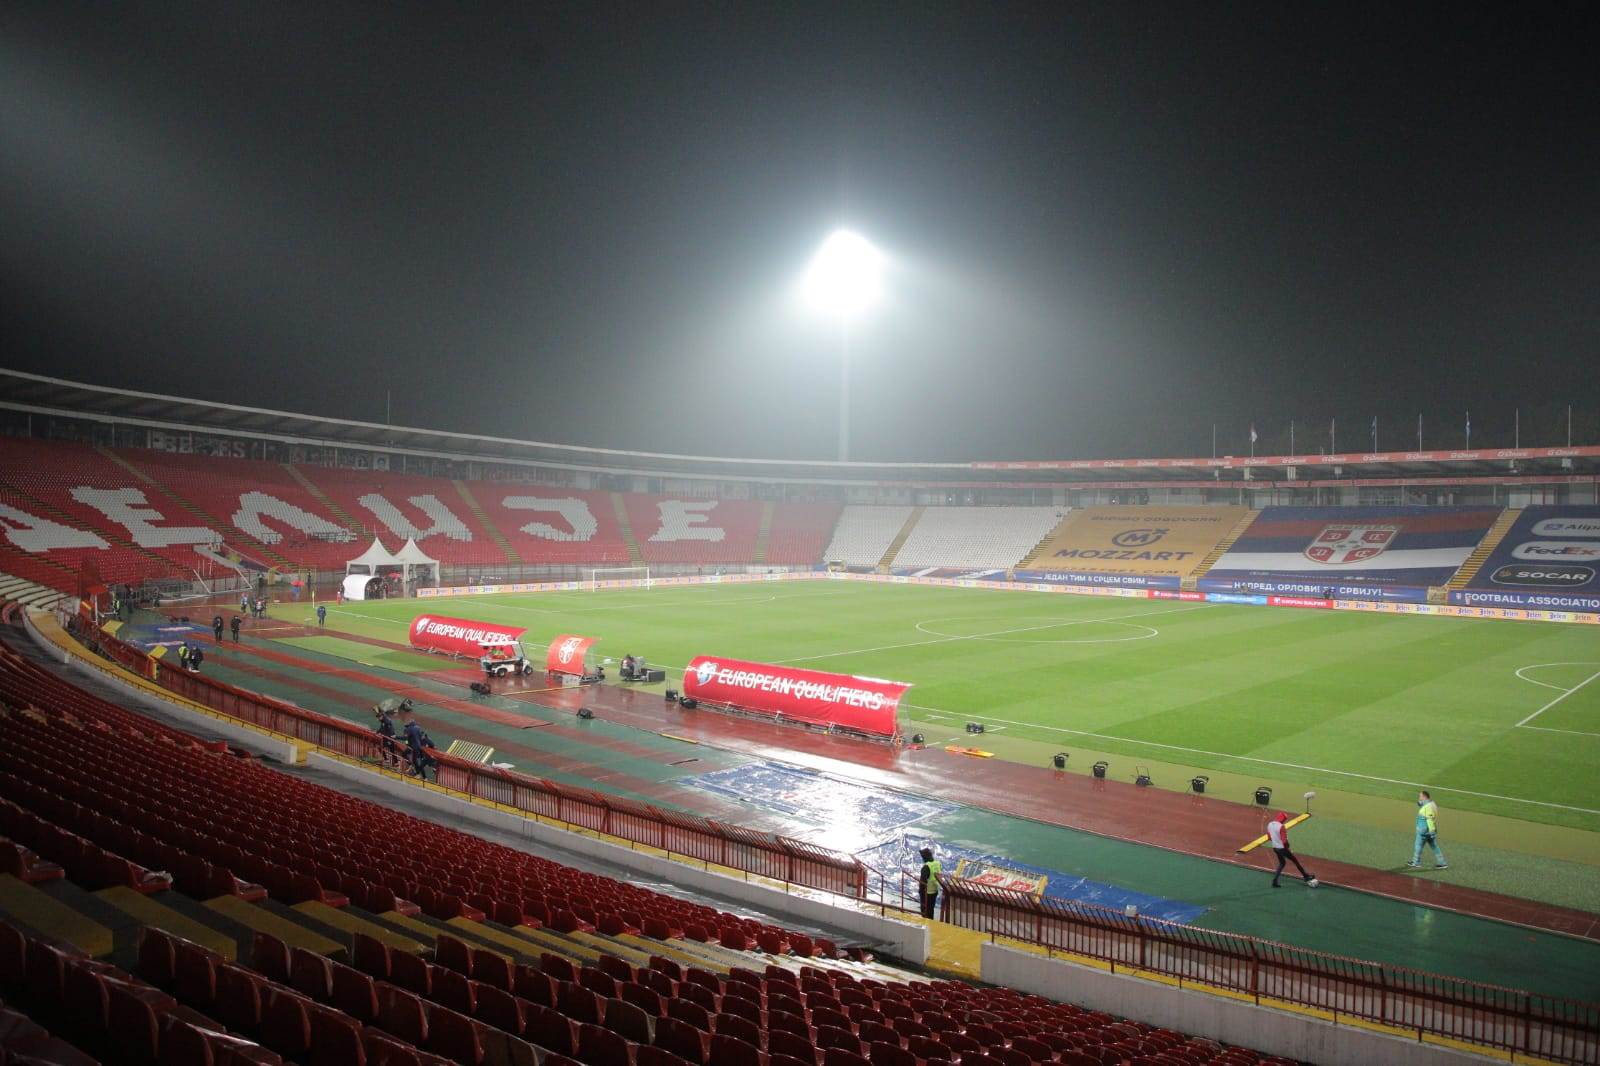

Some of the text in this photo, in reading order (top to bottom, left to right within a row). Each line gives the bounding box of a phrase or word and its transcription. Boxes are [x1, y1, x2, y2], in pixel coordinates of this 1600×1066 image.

[1054, 549, 1193, 560] MOZZART
[1523, 546, 1597, 555] FedEx
[1515, 571, 1587, 580] SOCAR
[426, 622, 512, 643] EUROPEAN QUALIFIERS
[717, 668, 884, 710] EUROPEAN QUALIFIERS
